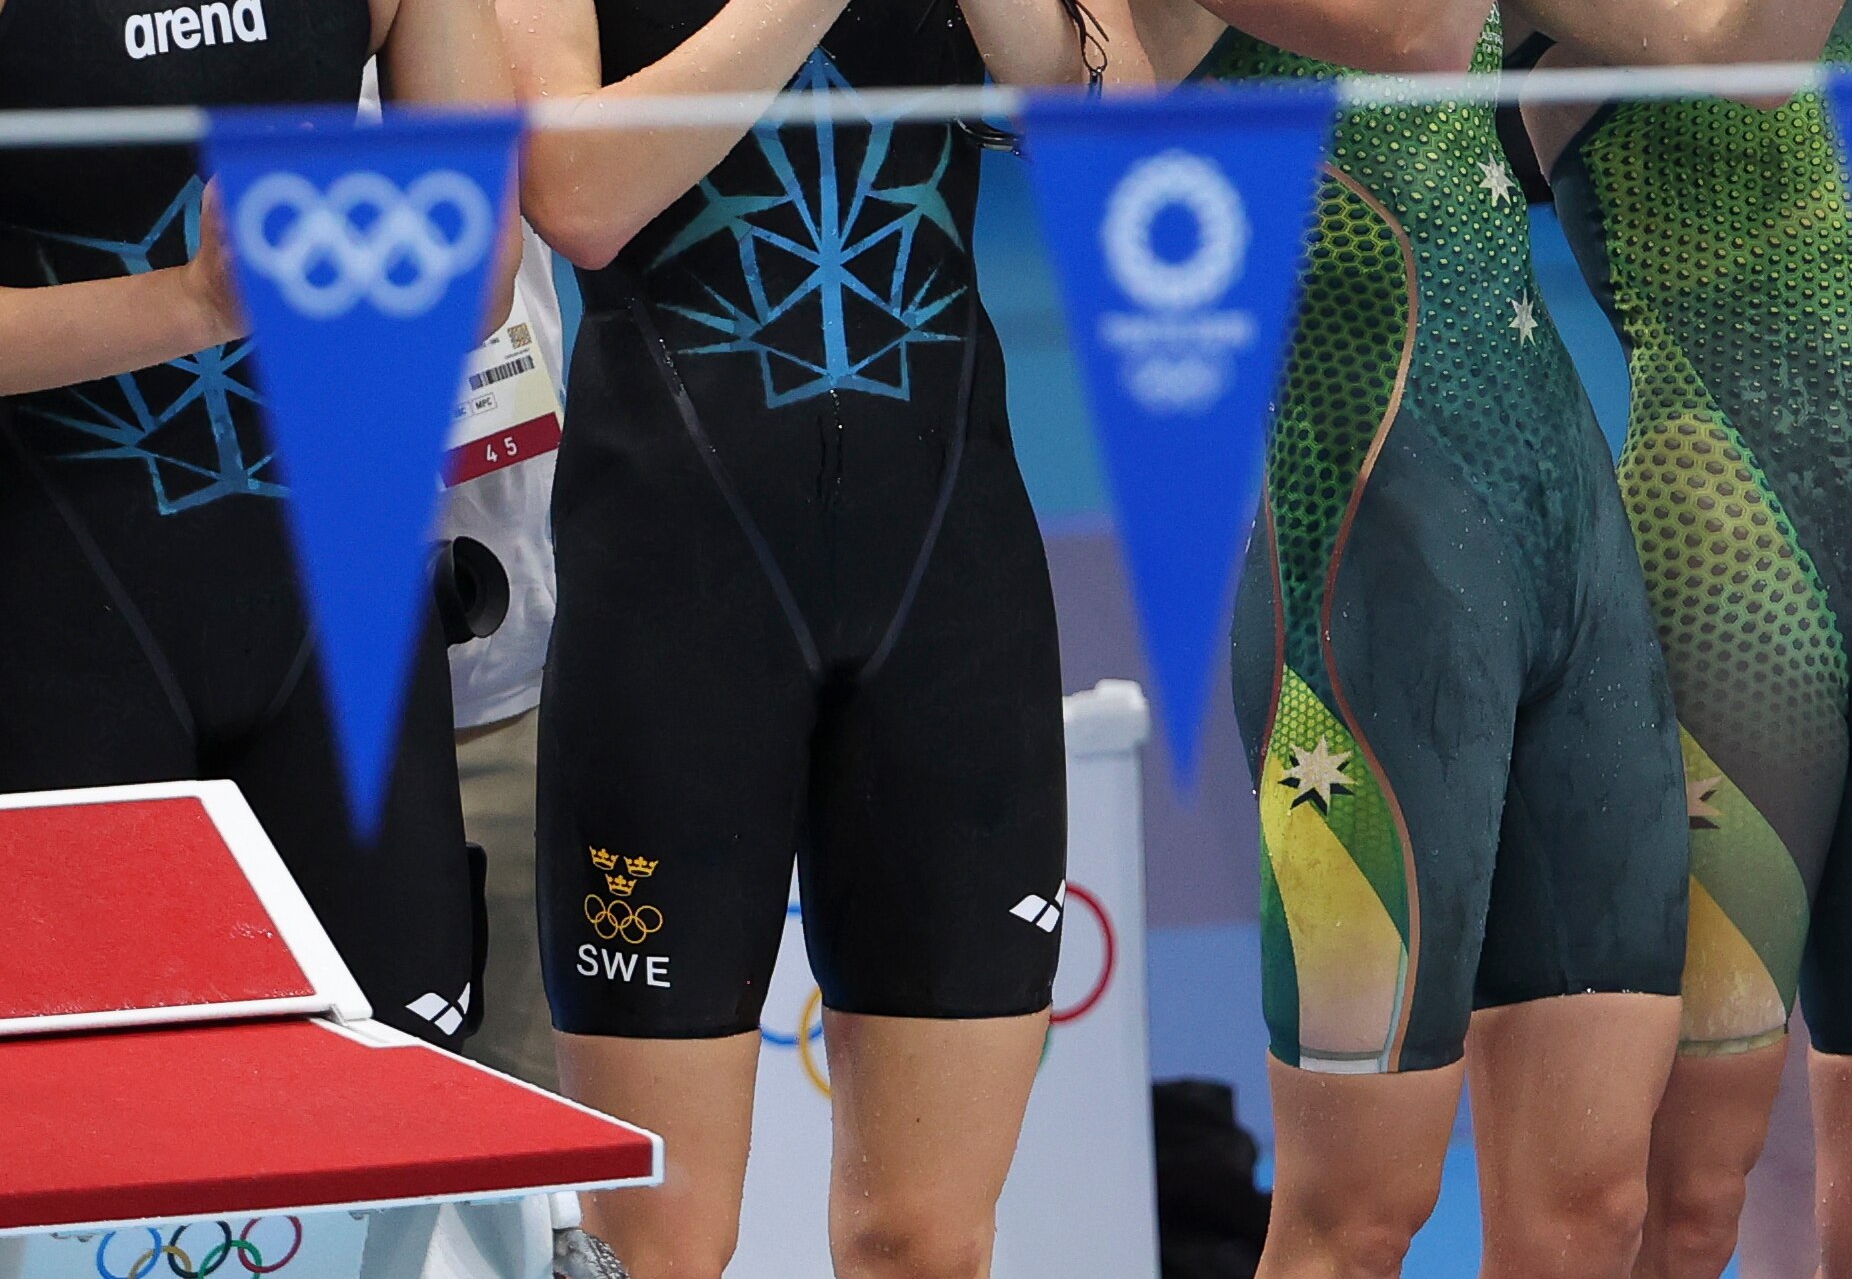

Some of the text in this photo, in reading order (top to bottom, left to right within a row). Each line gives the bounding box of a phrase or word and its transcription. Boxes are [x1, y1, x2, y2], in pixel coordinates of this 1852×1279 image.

[475, 397, 493, 410] MPC
[487, 437, 517, 462] 4 5
[577, 943, 671, 988] SWE
